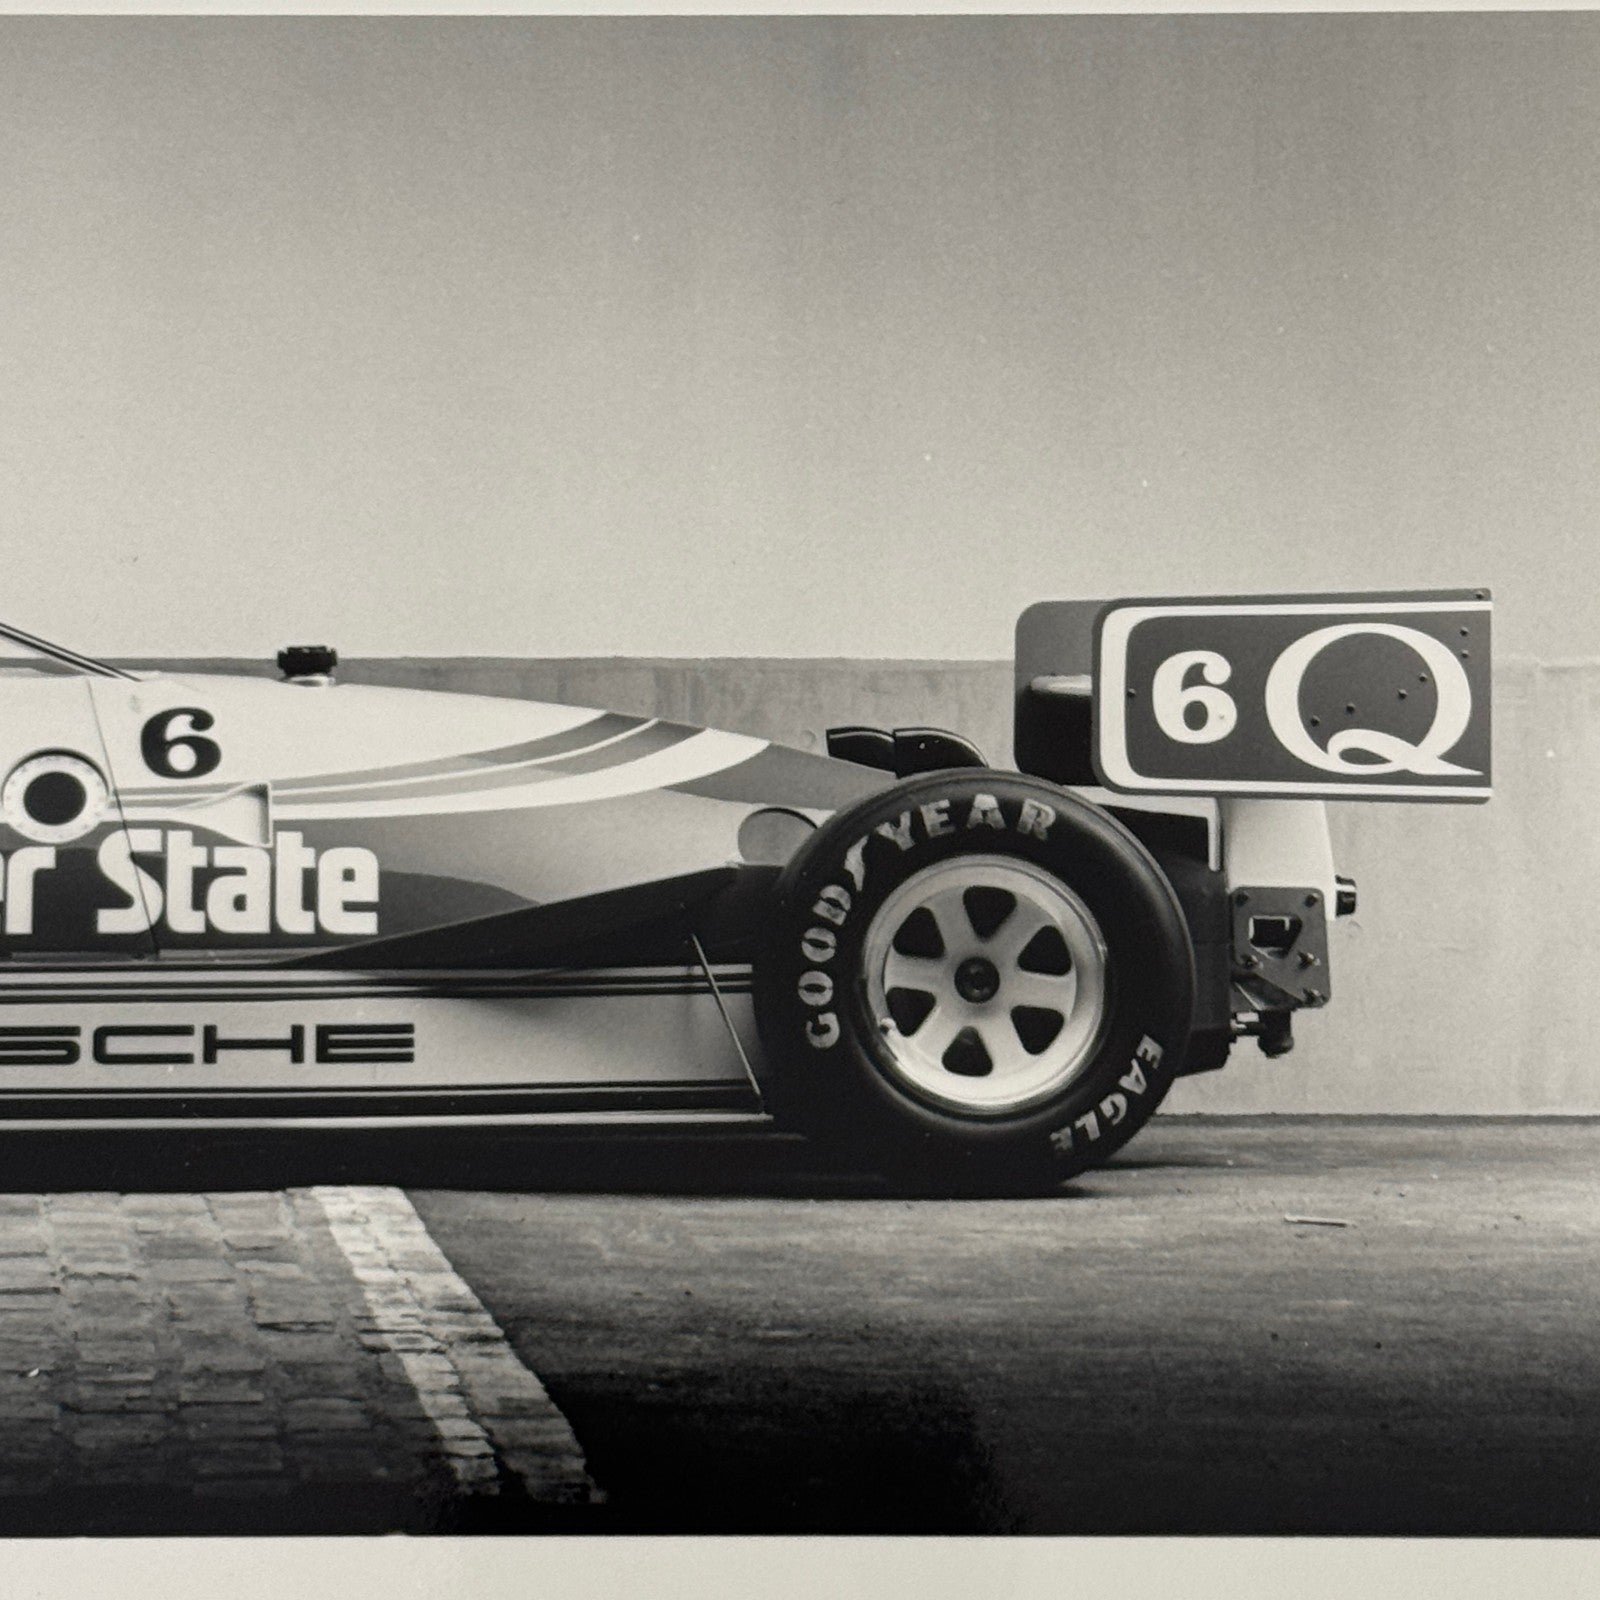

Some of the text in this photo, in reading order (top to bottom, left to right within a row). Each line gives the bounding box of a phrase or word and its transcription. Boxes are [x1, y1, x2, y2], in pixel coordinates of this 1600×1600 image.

[140, 707, 222, 779] 6
[1152, 622, 1484, 775] 6 Q
[0, 829, 380, 934] r State
[0, 1024, 415, 1064] SCHE
[1050, 1034, 1164, 1151] EAGLE
